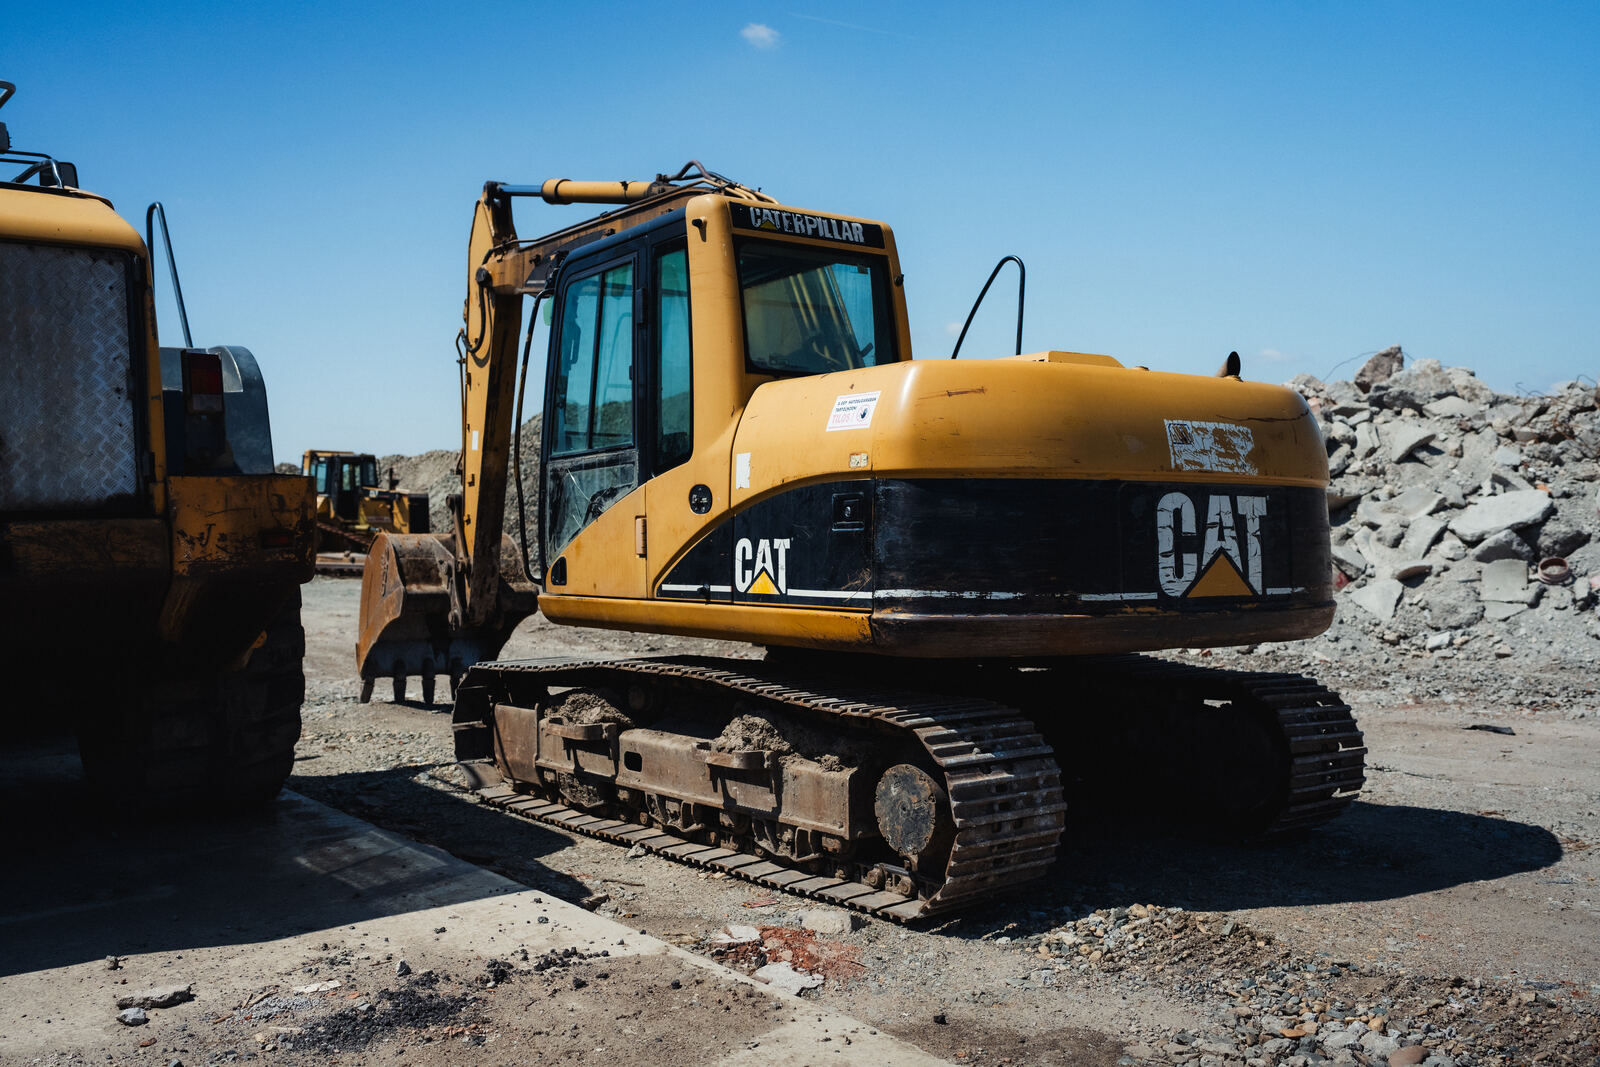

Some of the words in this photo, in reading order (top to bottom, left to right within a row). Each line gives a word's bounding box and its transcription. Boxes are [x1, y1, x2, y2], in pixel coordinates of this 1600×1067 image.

[749, 206, 865, 243] CATERPILLAR
[735, 537, 791, 594] CAT
[1156, 491, 1268, 598] CAT
